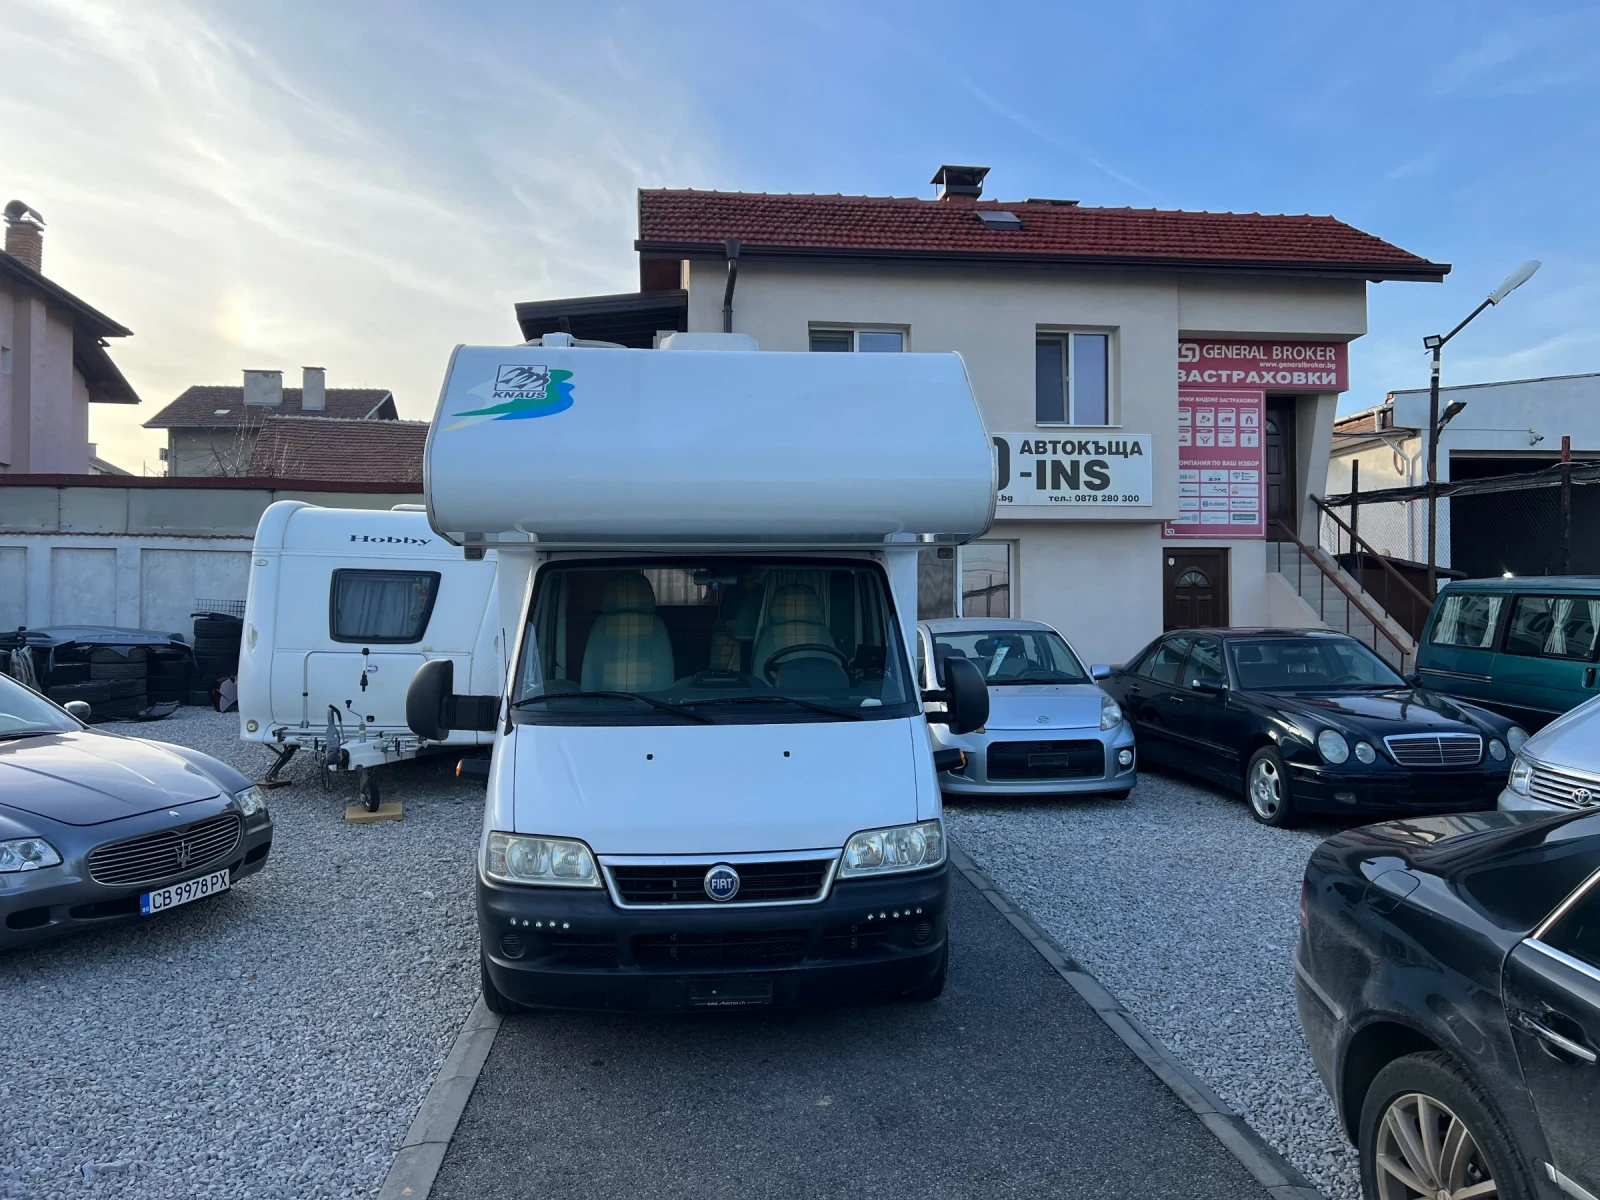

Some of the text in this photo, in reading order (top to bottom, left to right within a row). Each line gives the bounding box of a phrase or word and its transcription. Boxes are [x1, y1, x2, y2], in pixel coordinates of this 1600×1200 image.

[1203, 344, 1336, 361] GENERAL BROKER
[1259, 361, 1336, 370] www.generalbroker.bg
[1178, 369, 1337, 385] ЗАСТРАХОВКИ
[492, 391, 547, 399] KNAUS
[1019, 440, 1143, 458] АВТОКЪЩА
[1074, 494, 1098, 502] 0878
[1101, 494, 1119, 502] 280
[1121, 494, 1140, 502] 300
[350, 535, 433, 546] Hobby
[175, 878, 208, 903] 9978
[210, 871, 227, 891] PX
[711, 878, 733, 890] FIAT
